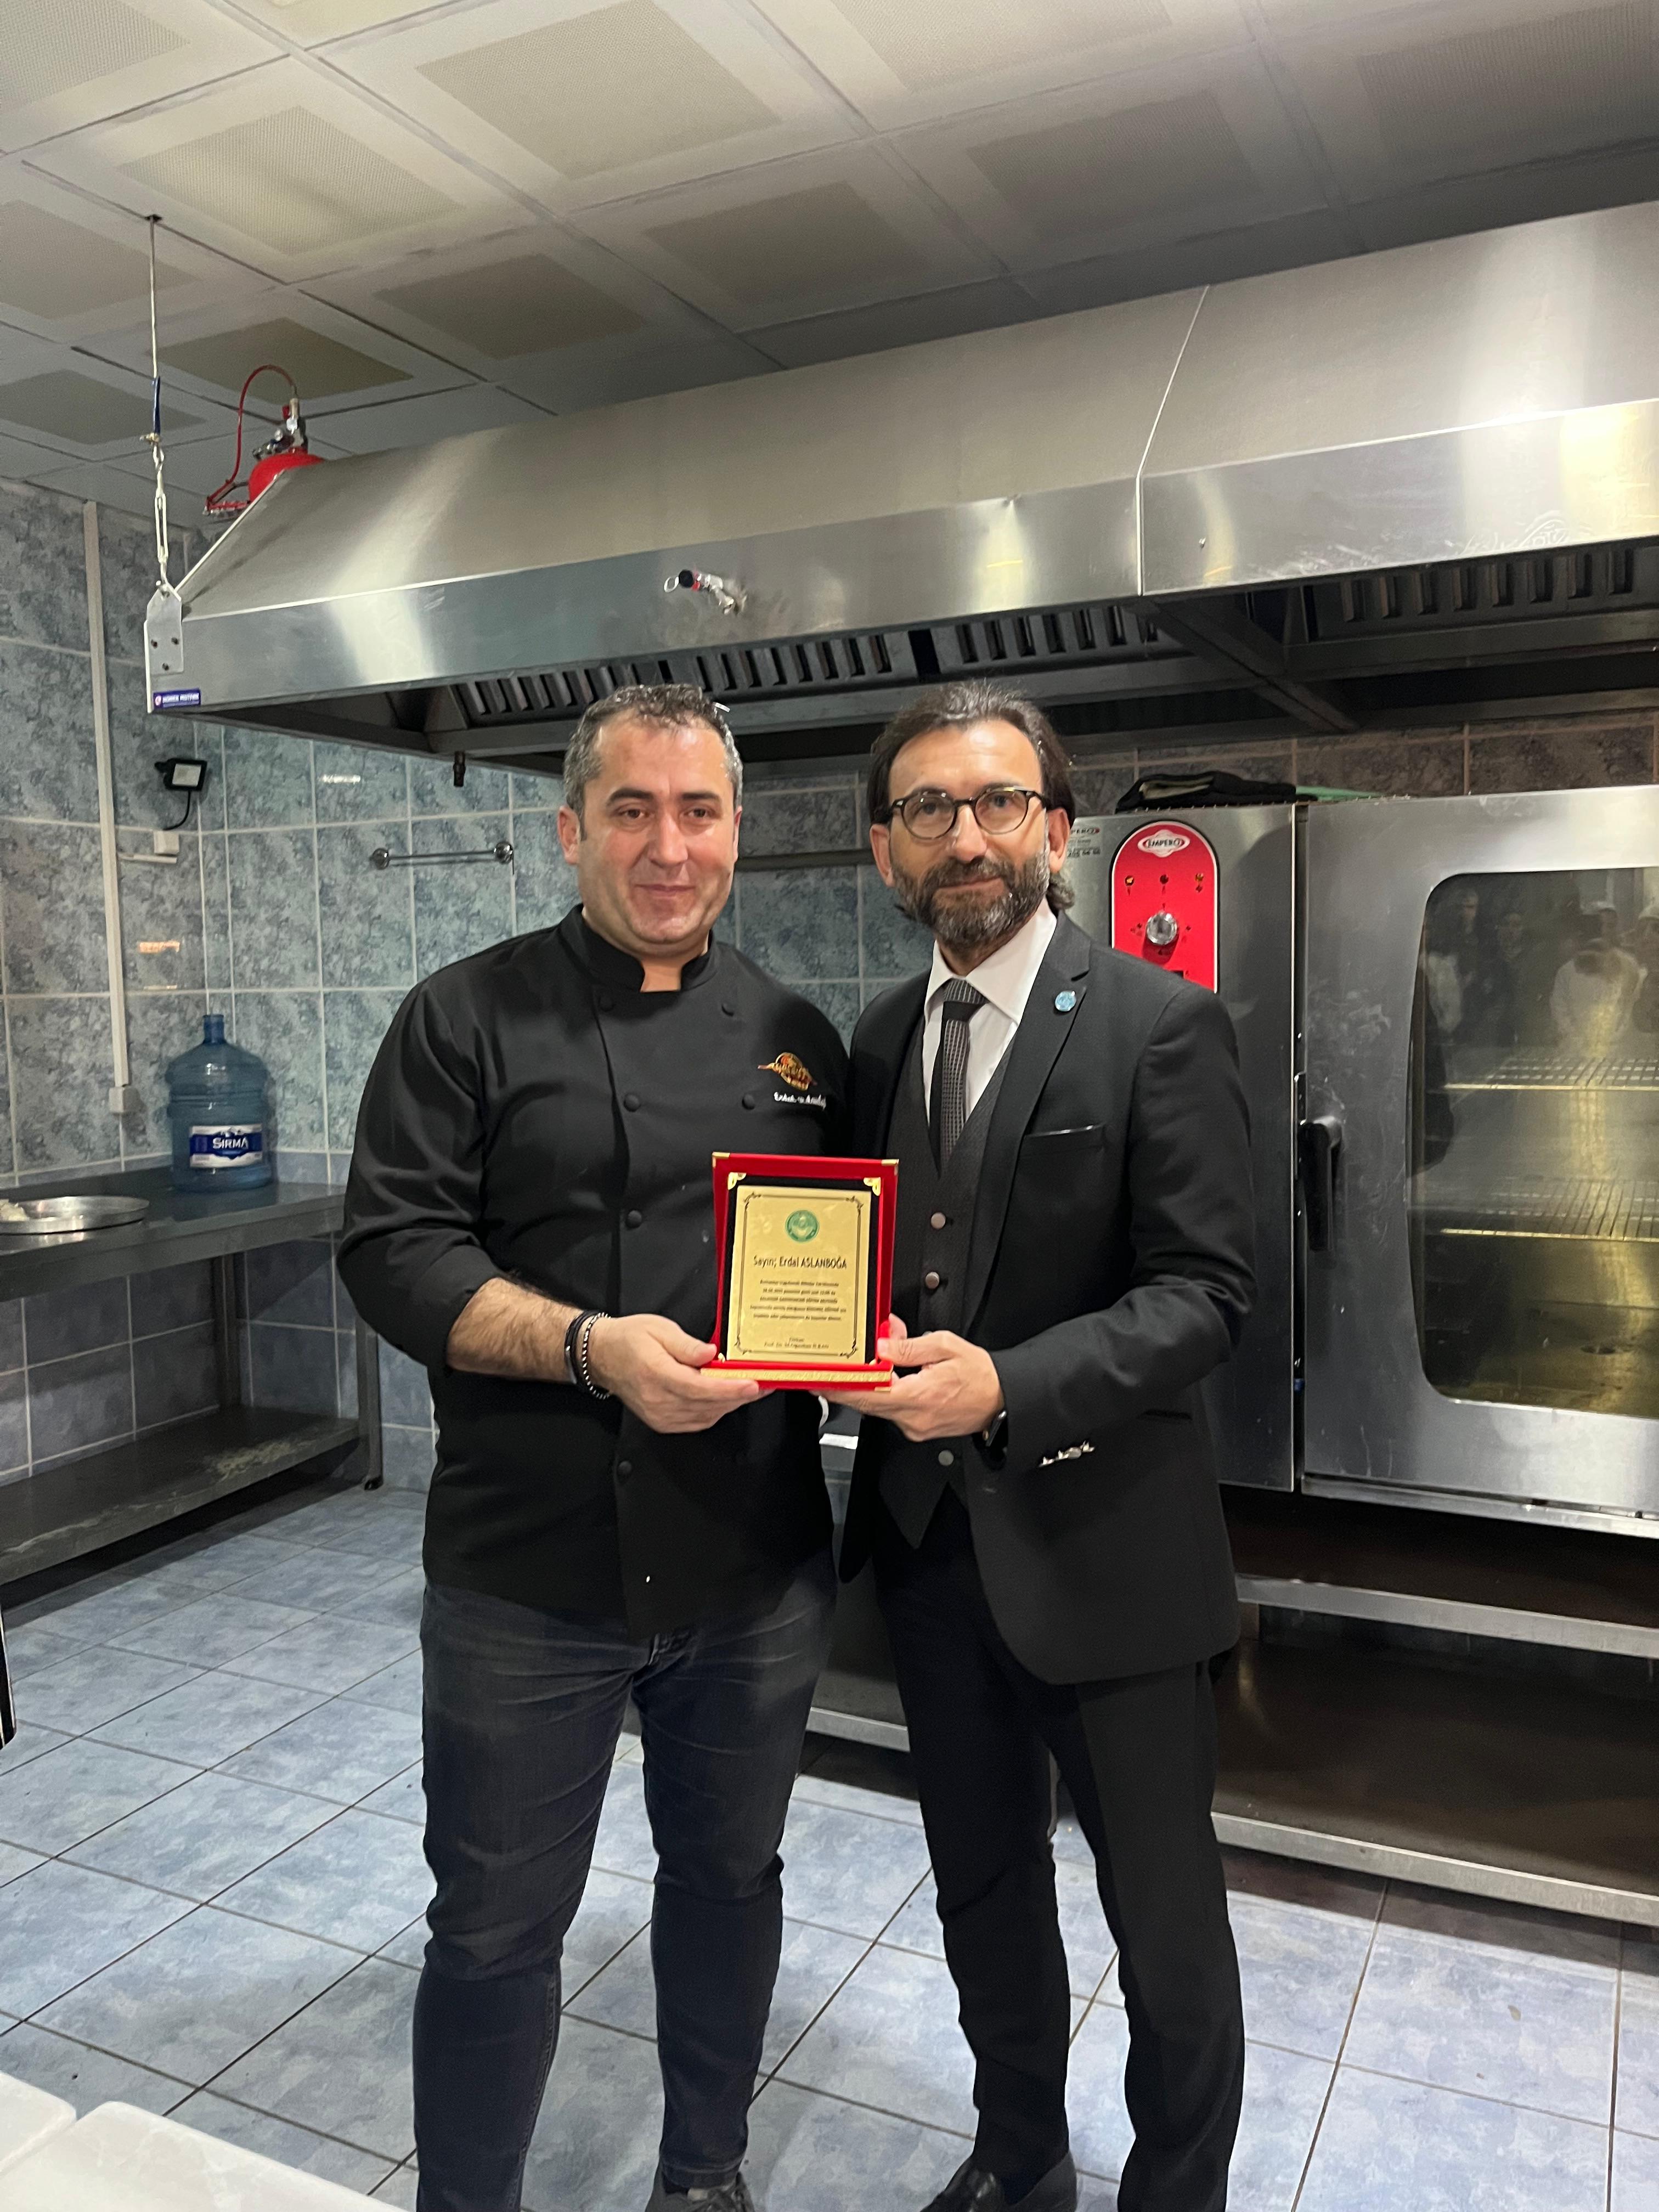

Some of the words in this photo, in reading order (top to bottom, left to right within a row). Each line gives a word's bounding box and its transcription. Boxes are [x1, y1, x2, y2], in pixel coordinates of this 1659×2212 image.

[212, 1136, 249, 1150] SIRMA
[779, 1256, 799, 1268] Erdal
[800, 1255, 847, 1269] ASLANBOĞA
